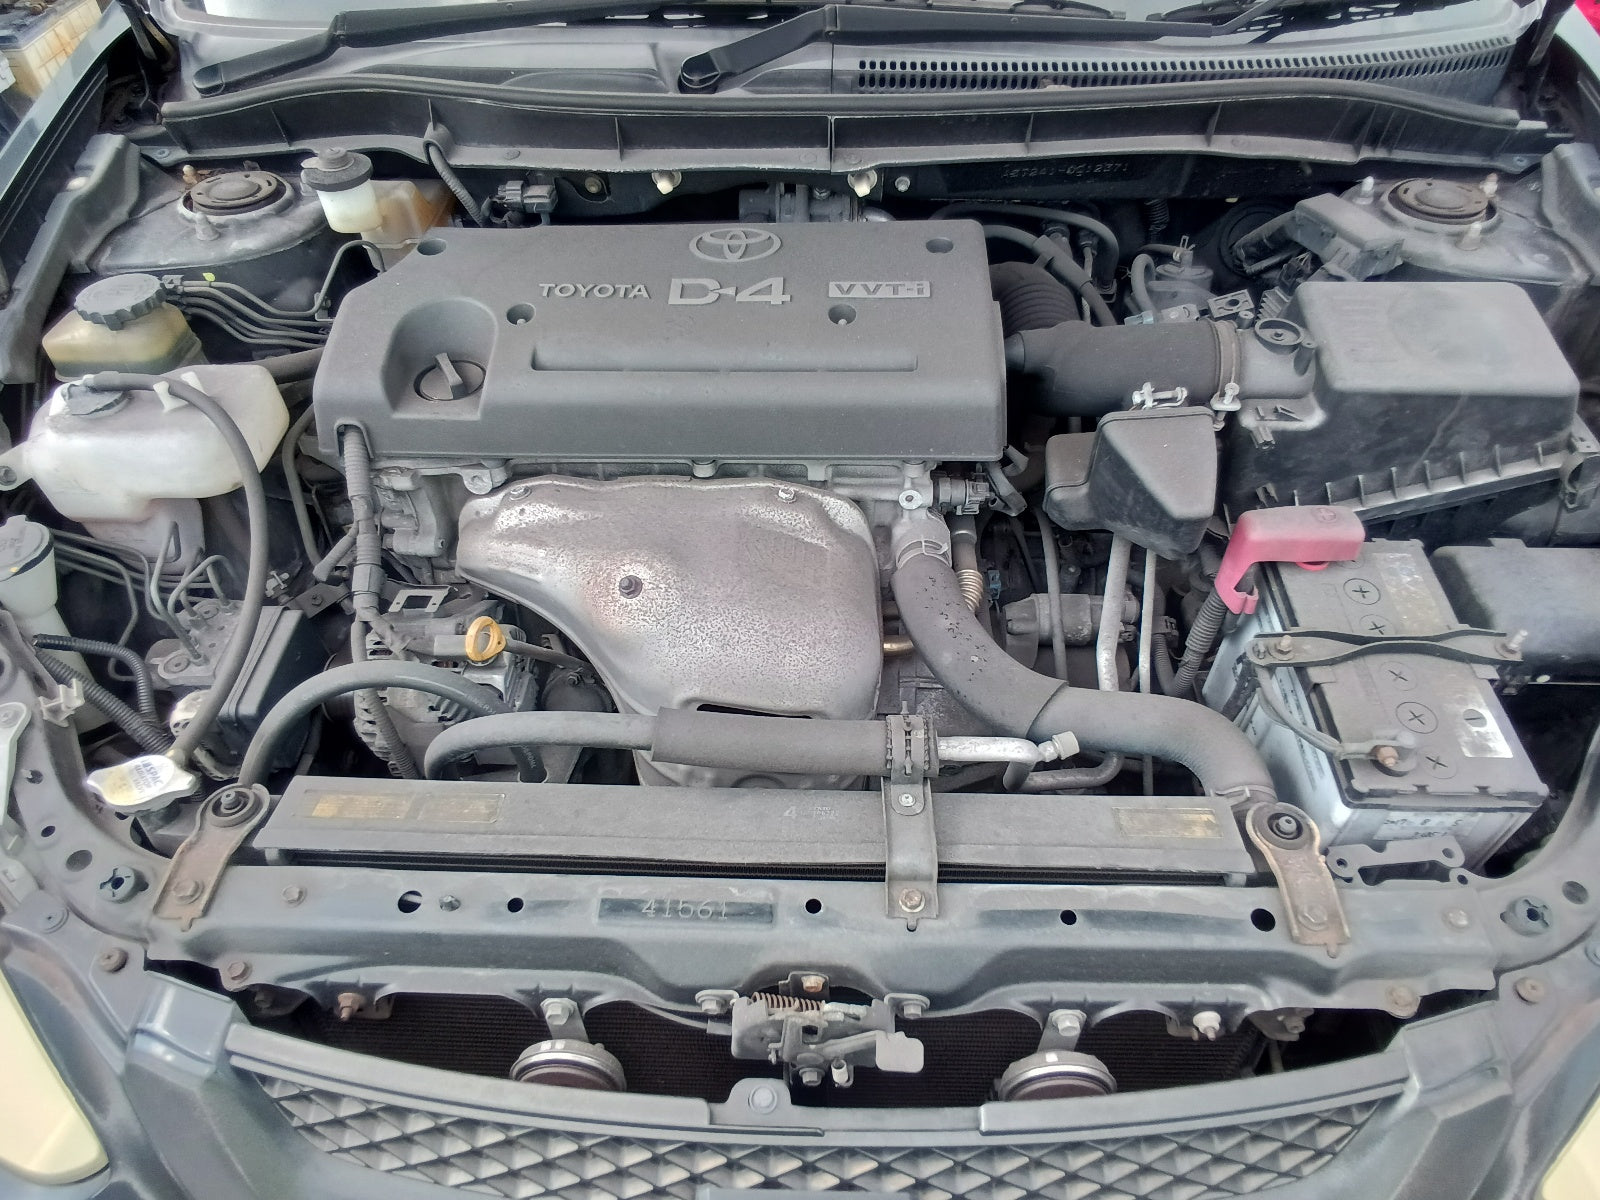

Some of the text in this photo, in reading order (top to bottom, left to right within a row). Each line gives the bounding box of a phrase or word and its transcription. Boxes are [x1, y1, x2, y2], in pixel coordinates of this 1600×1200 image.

[539, 277, 927, 305] TOYOTA D-4 VVT-i
[642, 899, 728, 919] 41561
